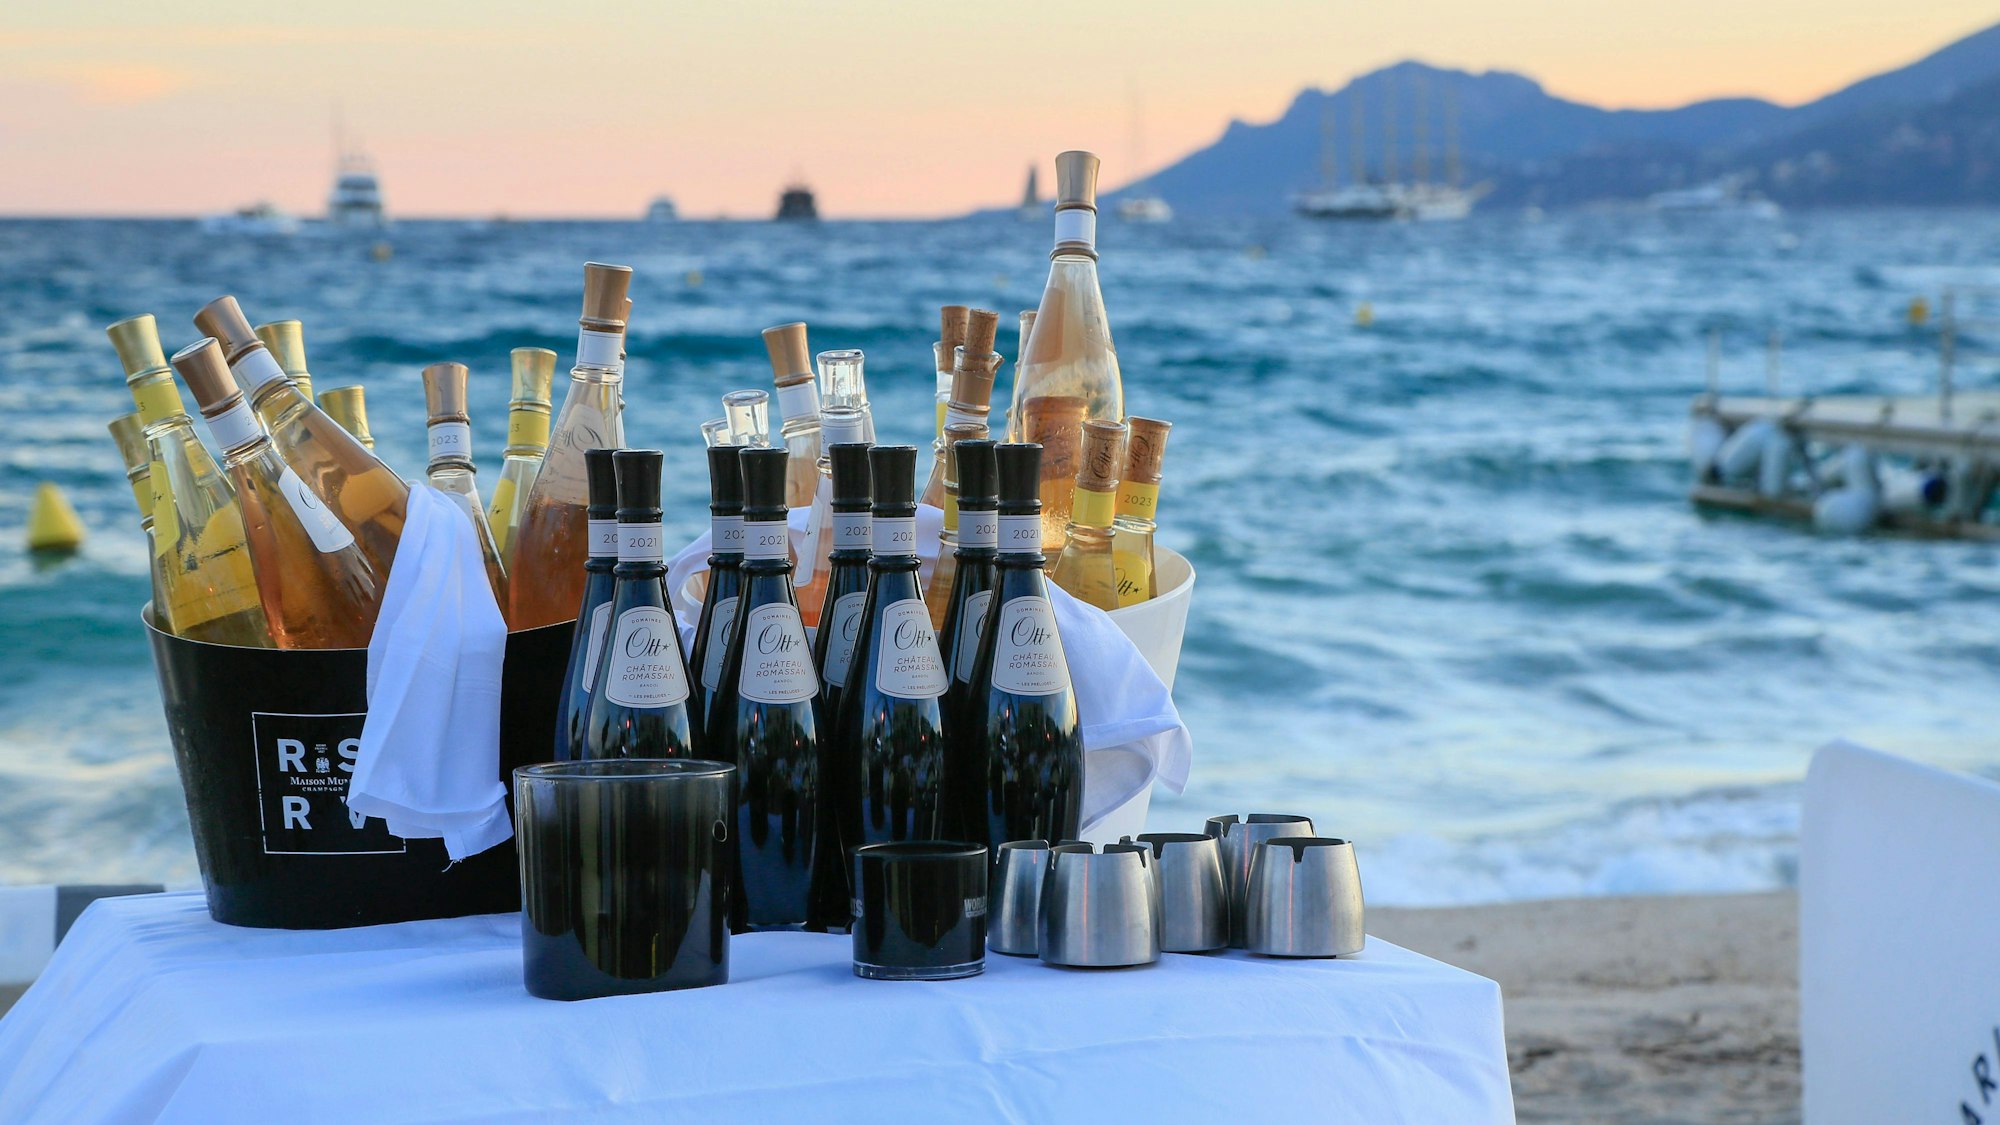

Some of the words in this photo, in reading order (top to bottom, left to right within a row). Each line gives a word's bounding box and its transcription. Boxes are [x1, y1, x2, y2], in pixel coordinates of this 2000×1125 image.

[431, 434, 459, 447] 2023
[1124, 495, 1152, 507] 2023
[845, 526, 872, 536] 2021
[975, 524, 997, 535] 202
[1012, 529, 1039, 540] 2021
[759, 535, 786, 546] 2021
[892, 531, 914, 542] 202
[629, 537, 657, 548] 2021
[894, 618, 926, 650] Ott
[1011, 615, 1045, 647] Ott
[625, 626, 661, 659] Ott
[757, 623, 792, 655] Ott
[897, 655, 936, 665] CHÂTEAU
[1012, 652, 1054, 661] CHÂTEAU
[626, 663, 671, 673] CHÂTEAU
[759, 660, 802, 669] CHÂTEAU
[893, 664, 939, 673] ROMASSAN
[1008, 660, 1058, 670] ROMASSAN
[622, 672, 675, 681] ROMASSAN
[755, 668, 806, 677] ROMASSAN
[277, 738, 308, 773] R
[282, 796, 313, 830] R
